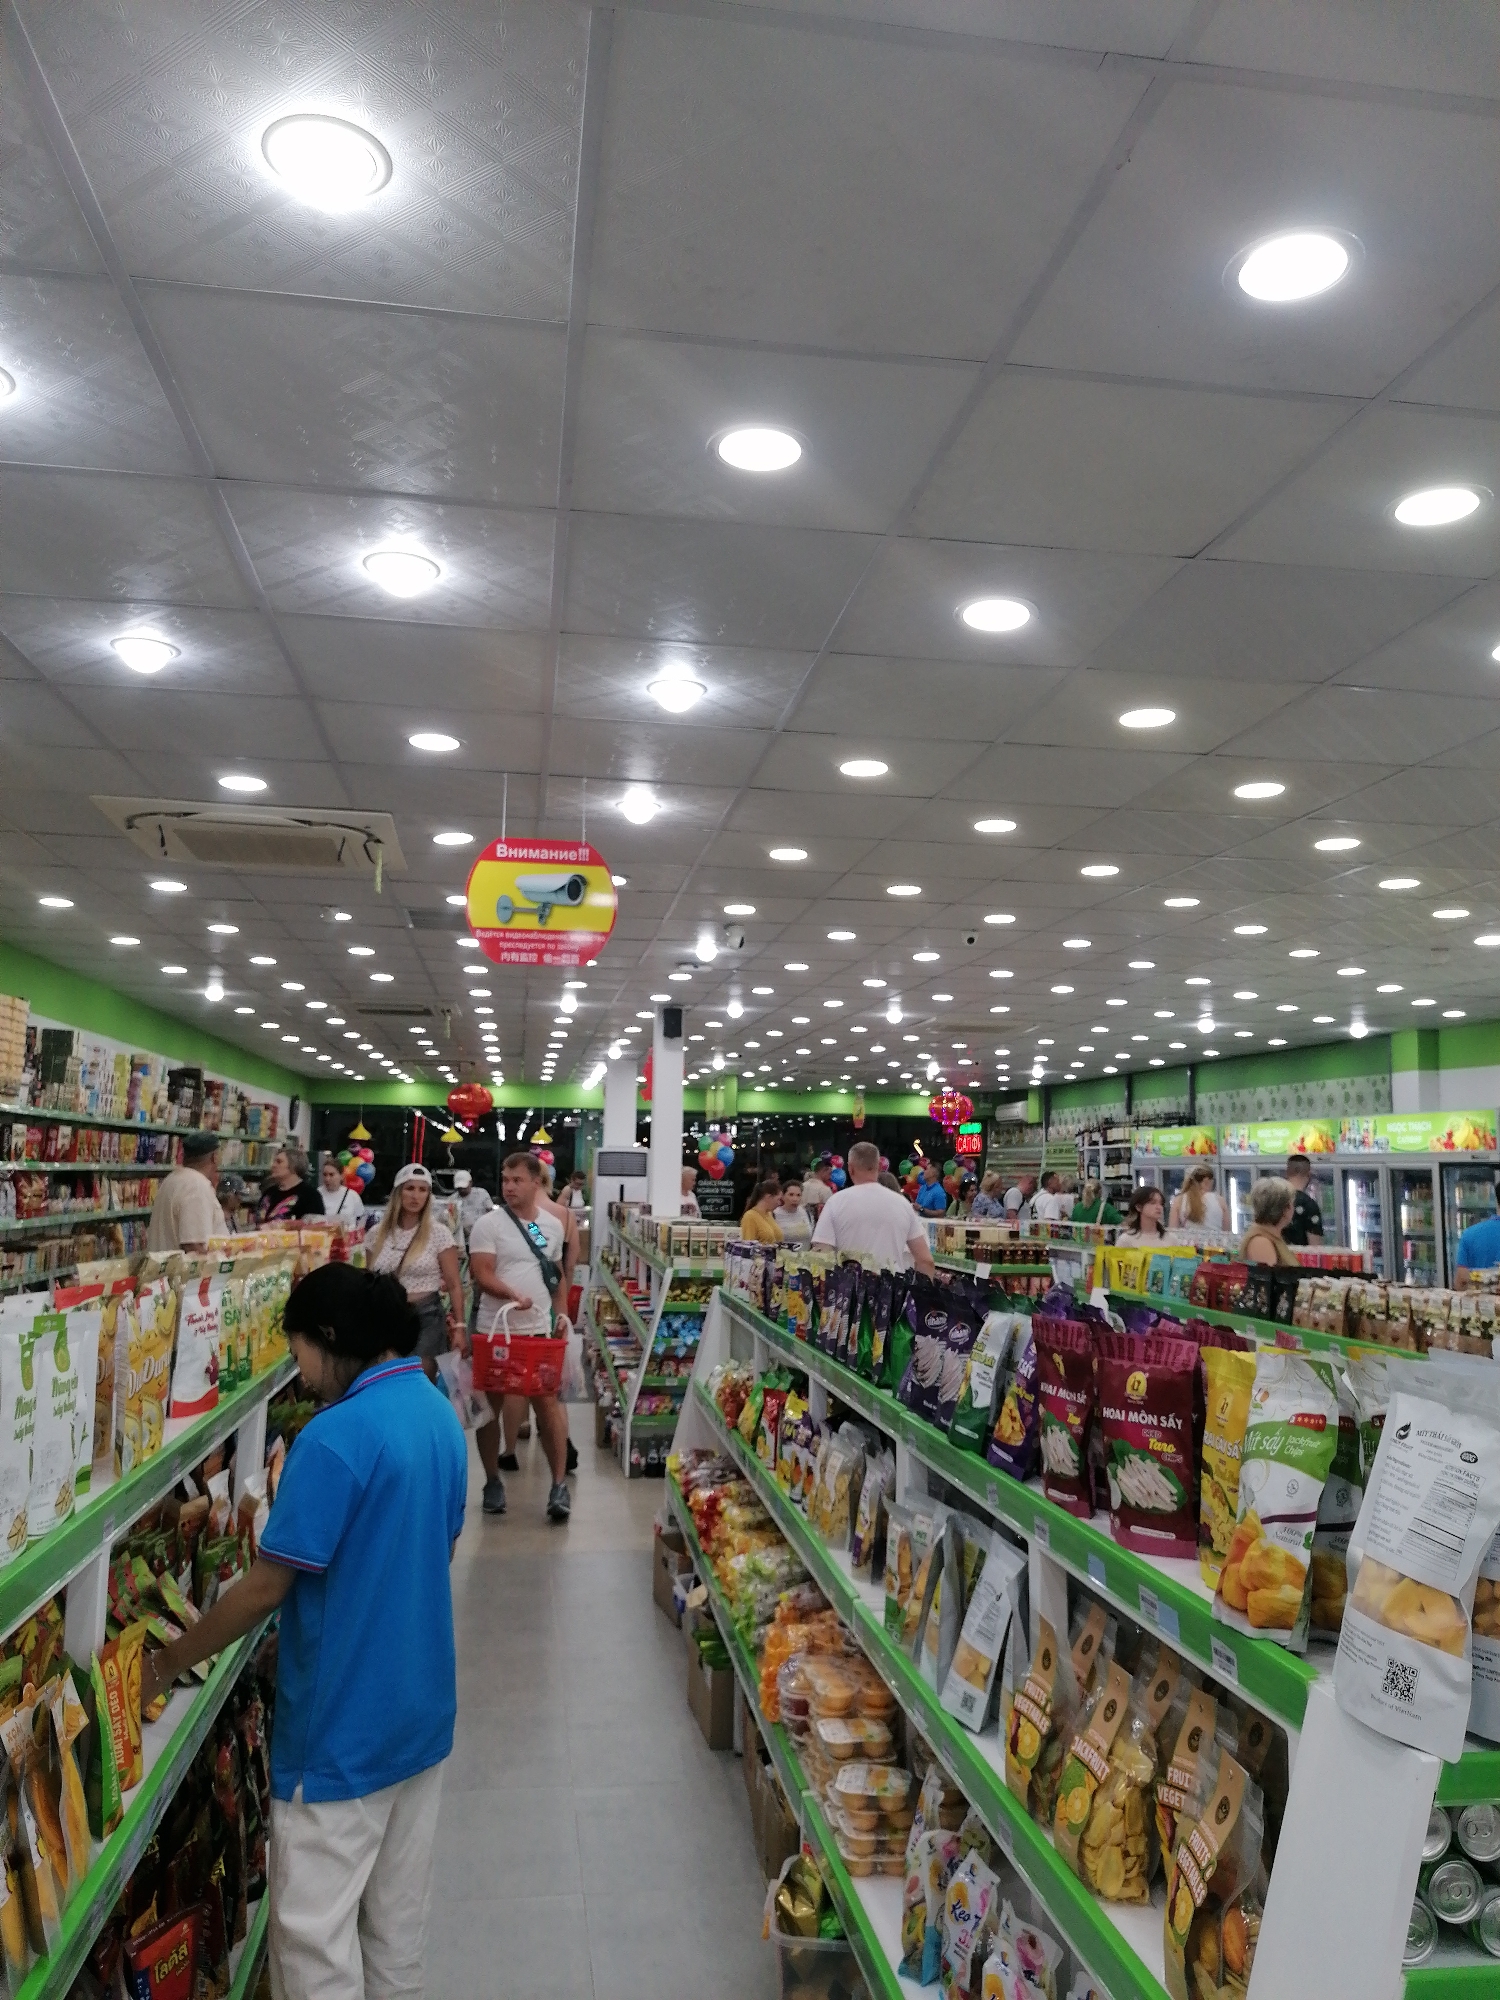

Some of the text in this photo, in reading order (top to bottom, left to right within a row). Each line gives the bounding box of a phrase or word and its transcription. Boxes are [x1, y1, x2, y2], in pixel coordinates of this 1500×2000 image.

[496, 843, 590, 862] Внимание!!!
[1143, 1339, 1195, 1369] CHIPS
[1128, 1409, 1158, 1426] MÔN
[1160, 1412, 1183, 1430] SẤY
[1149, 1437, 1177, 1453] Taro
[1260, 1427, 1285, 1456] sấy
[1284, 1444, 1305, 1457] Chips
[1286, 1434, 1321, 1450] Jackfruit
[1462, 1469, 1481, 1482] FACTS
[1273, 1531, 1302, 1547] Natural
[1071, 1735, 1111, 1783] JACKFRUIT
[1188, 1829, 1211, 1870] FRUITS
[1177, 1843, 1207, 1908] VEGETABLES
